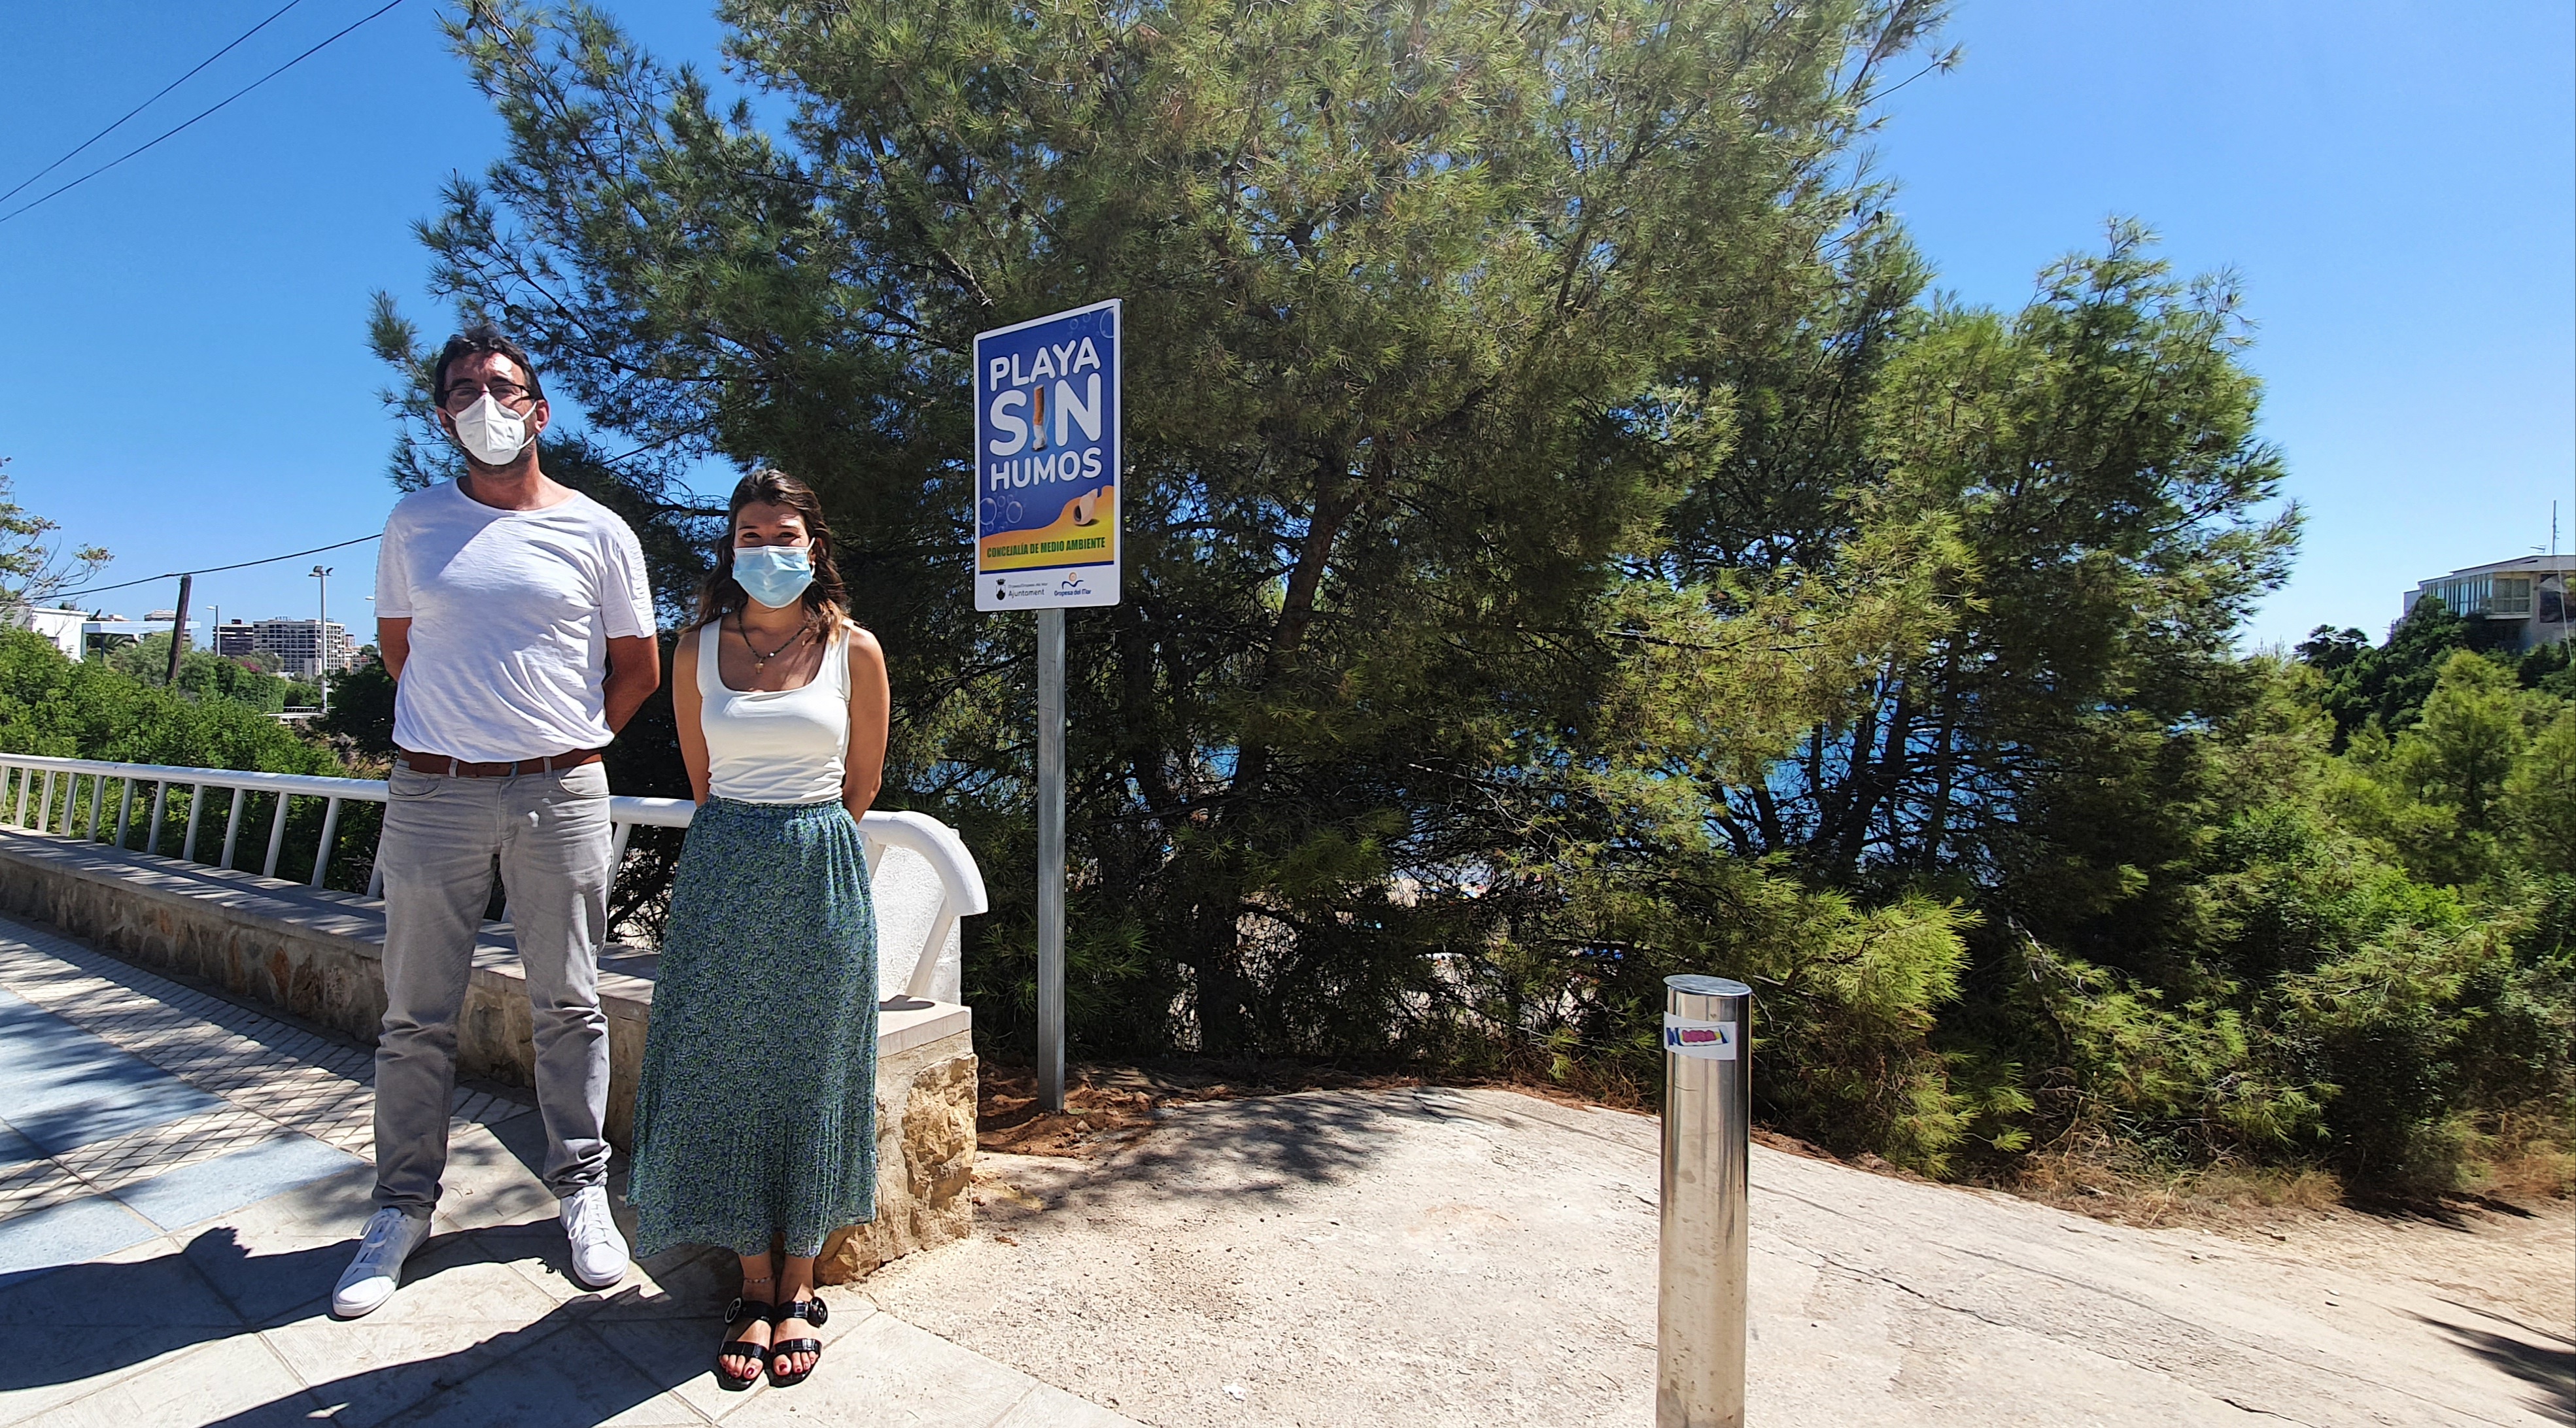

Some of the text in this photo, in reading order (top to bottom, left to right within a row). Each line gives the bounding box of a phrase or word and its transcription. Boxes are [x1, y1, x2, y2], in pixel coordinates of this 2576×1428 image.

[990, 336, 1101, 392] PLAYA
[989, 373, 1102, 456] SIN
[990, 447, 1102, 492] HUMOS
[987, 537, 1106, 558] CONCEJALÍA DE MEDIO AMBIENTE
[1008, 589, 1044, 599] Ajuntament
